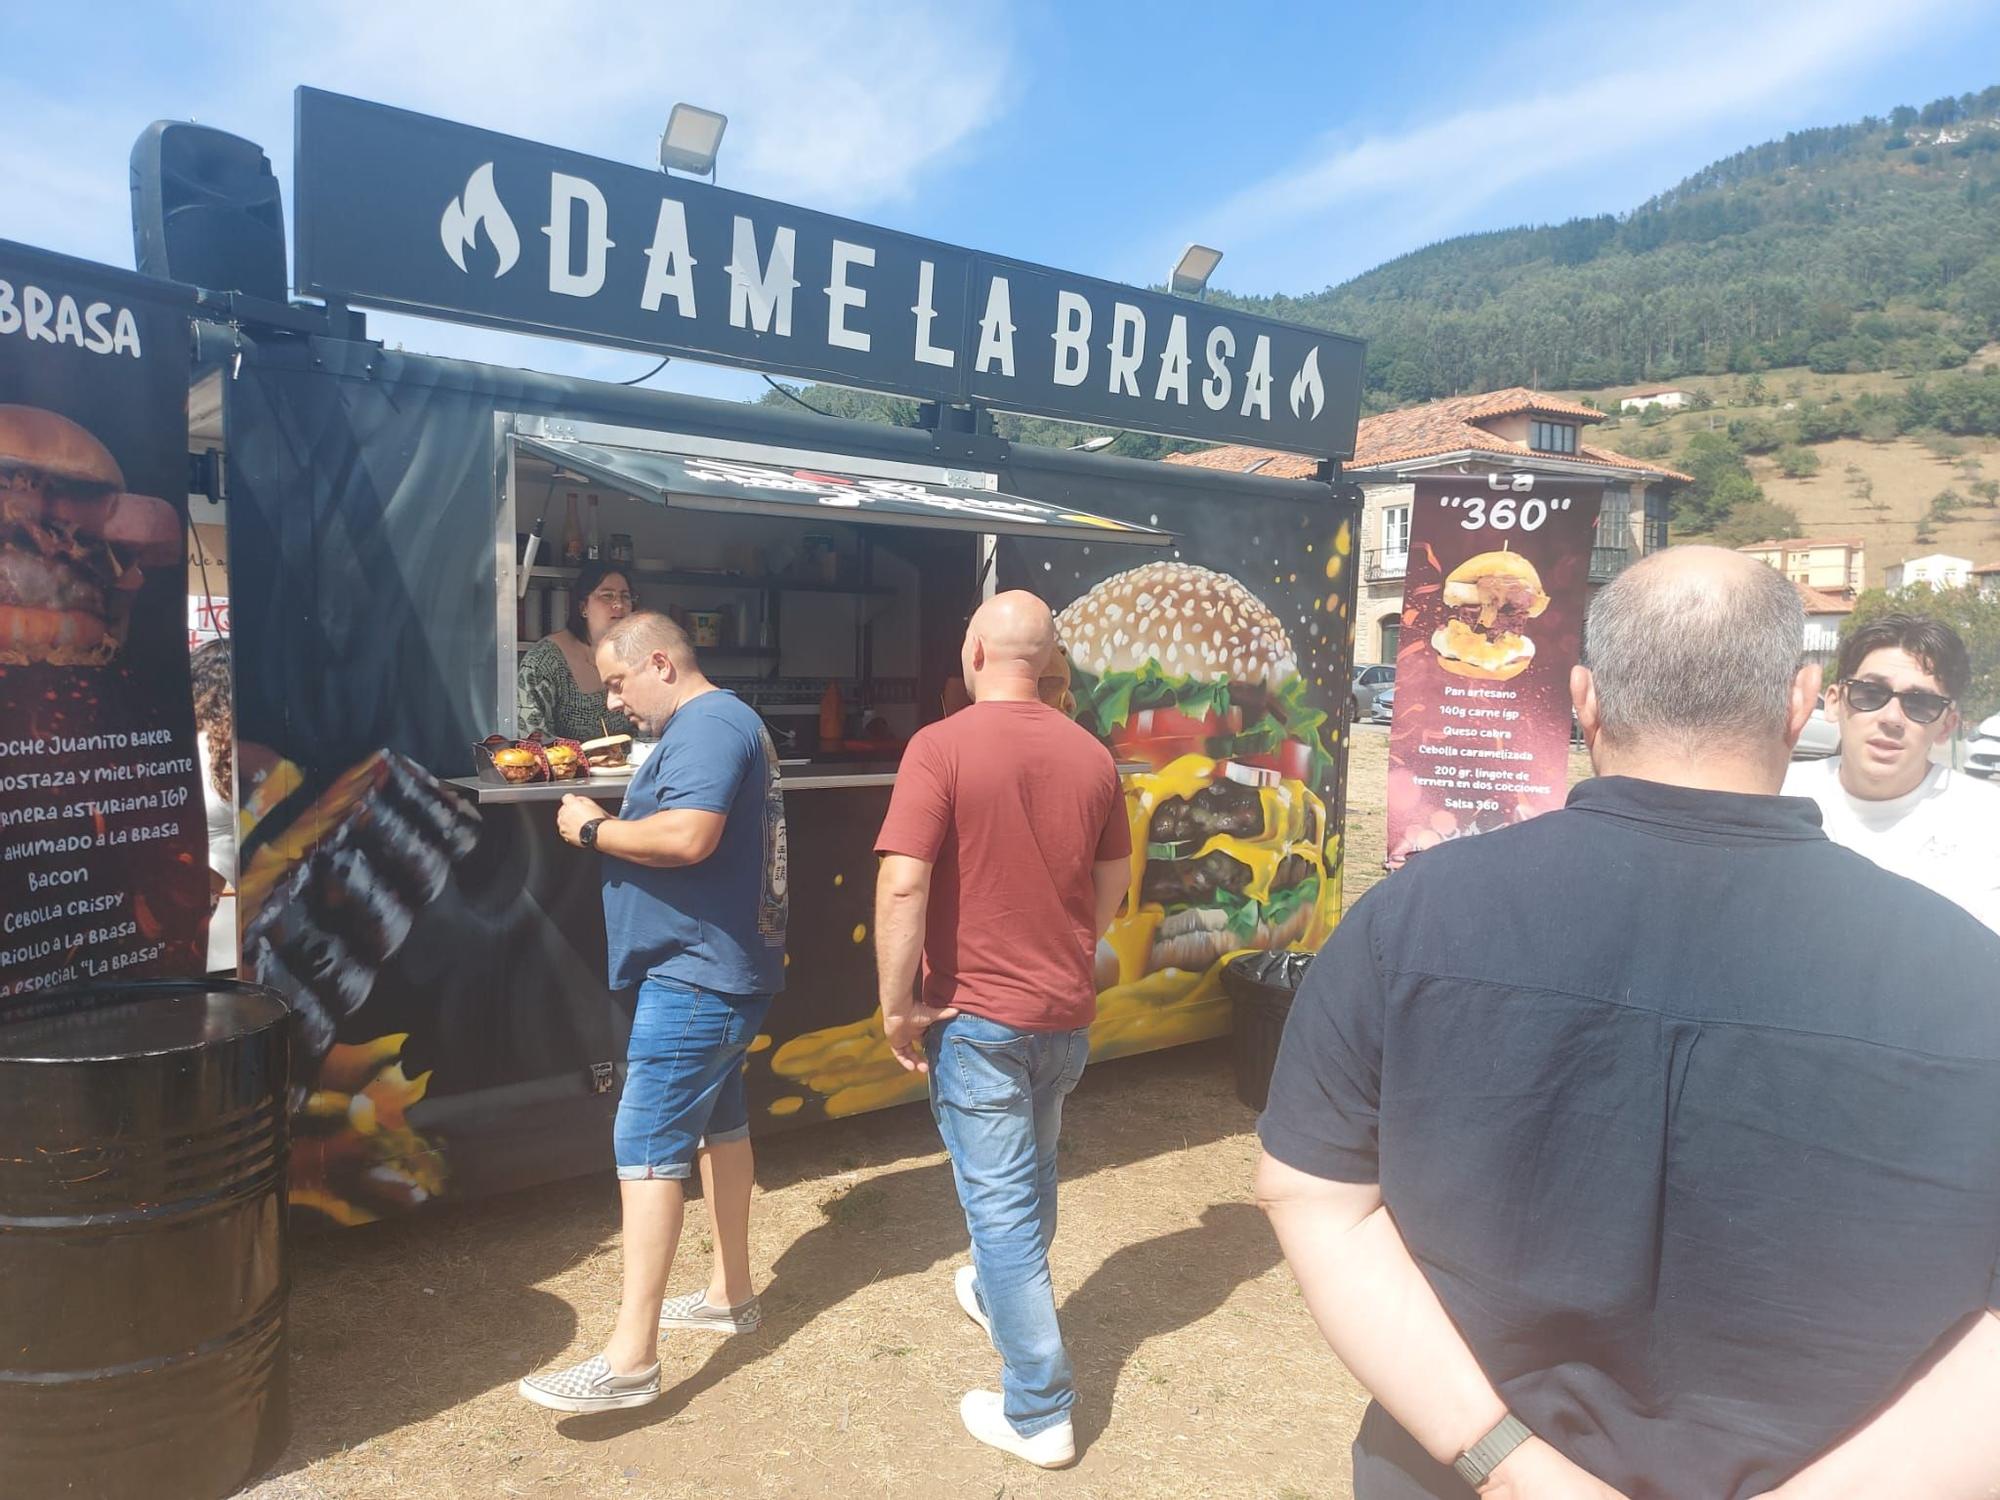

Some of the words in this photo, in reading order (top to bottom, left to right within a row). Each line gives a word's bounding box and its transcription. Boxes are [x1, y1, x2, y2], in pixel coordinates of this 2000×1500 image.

[540, 172, 875, 352] DAME
[911, 260, 1017, 377] LA
[1050, 290, 1273, 420] BRASA
[0, 279, 141, 358] BRASA
[1445, 687, 1465, 697] Pan
[1467, 688, 1517, 699] artesano
[1468, 709, 1500, 718] carne
[1443, 726, 1477, 737] Queso
[1480, 728, 1511, 739] cabra
[1419, 744, 1458, 756] Cebolla
[1460, 748, 1533, 761] caramelizada
[1434, 765, 1456, 776] 200
[1475, 767, 1513, 781] lingote
[1515, 770, 1530, 780] de
[1413, 776, 1454, 788] ternera
[1456, 780, 1470, 789] en
[1473, 780, 1493, 791] dos
[1495, 782, 1552, 794] cocciones
[160, 787, 188, 808] IGP
[1445, 798, 1474, 810] Salsa
[1477, 799, 1499, 811] 360
